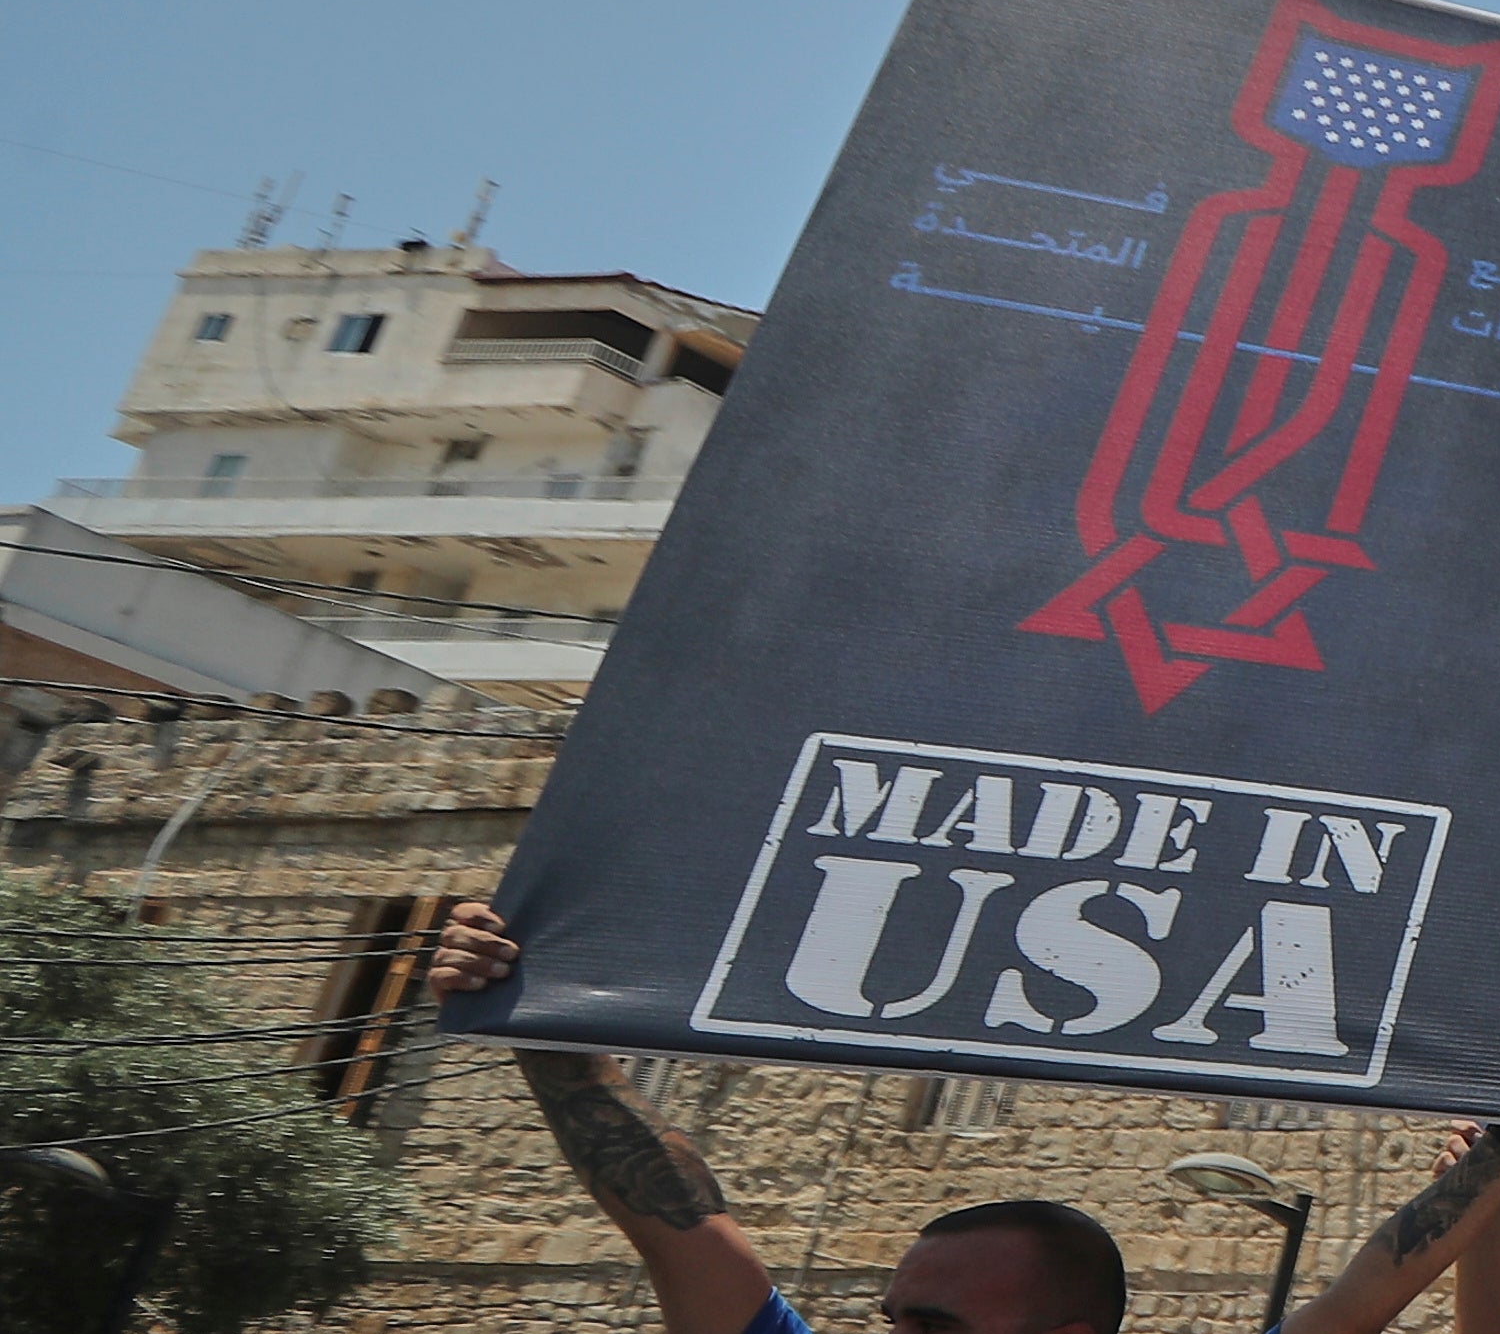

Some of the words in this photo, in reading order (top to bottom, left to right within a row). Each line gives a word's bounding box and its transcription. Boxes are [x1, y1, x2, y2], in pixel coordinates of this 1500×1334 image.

[915, 204, 1147, 269] المتحدة
[809, 758, 1211, 875] MADE
[1245, 807, 1404, 893] IN
[785, 857, 1349, 1056] USA
